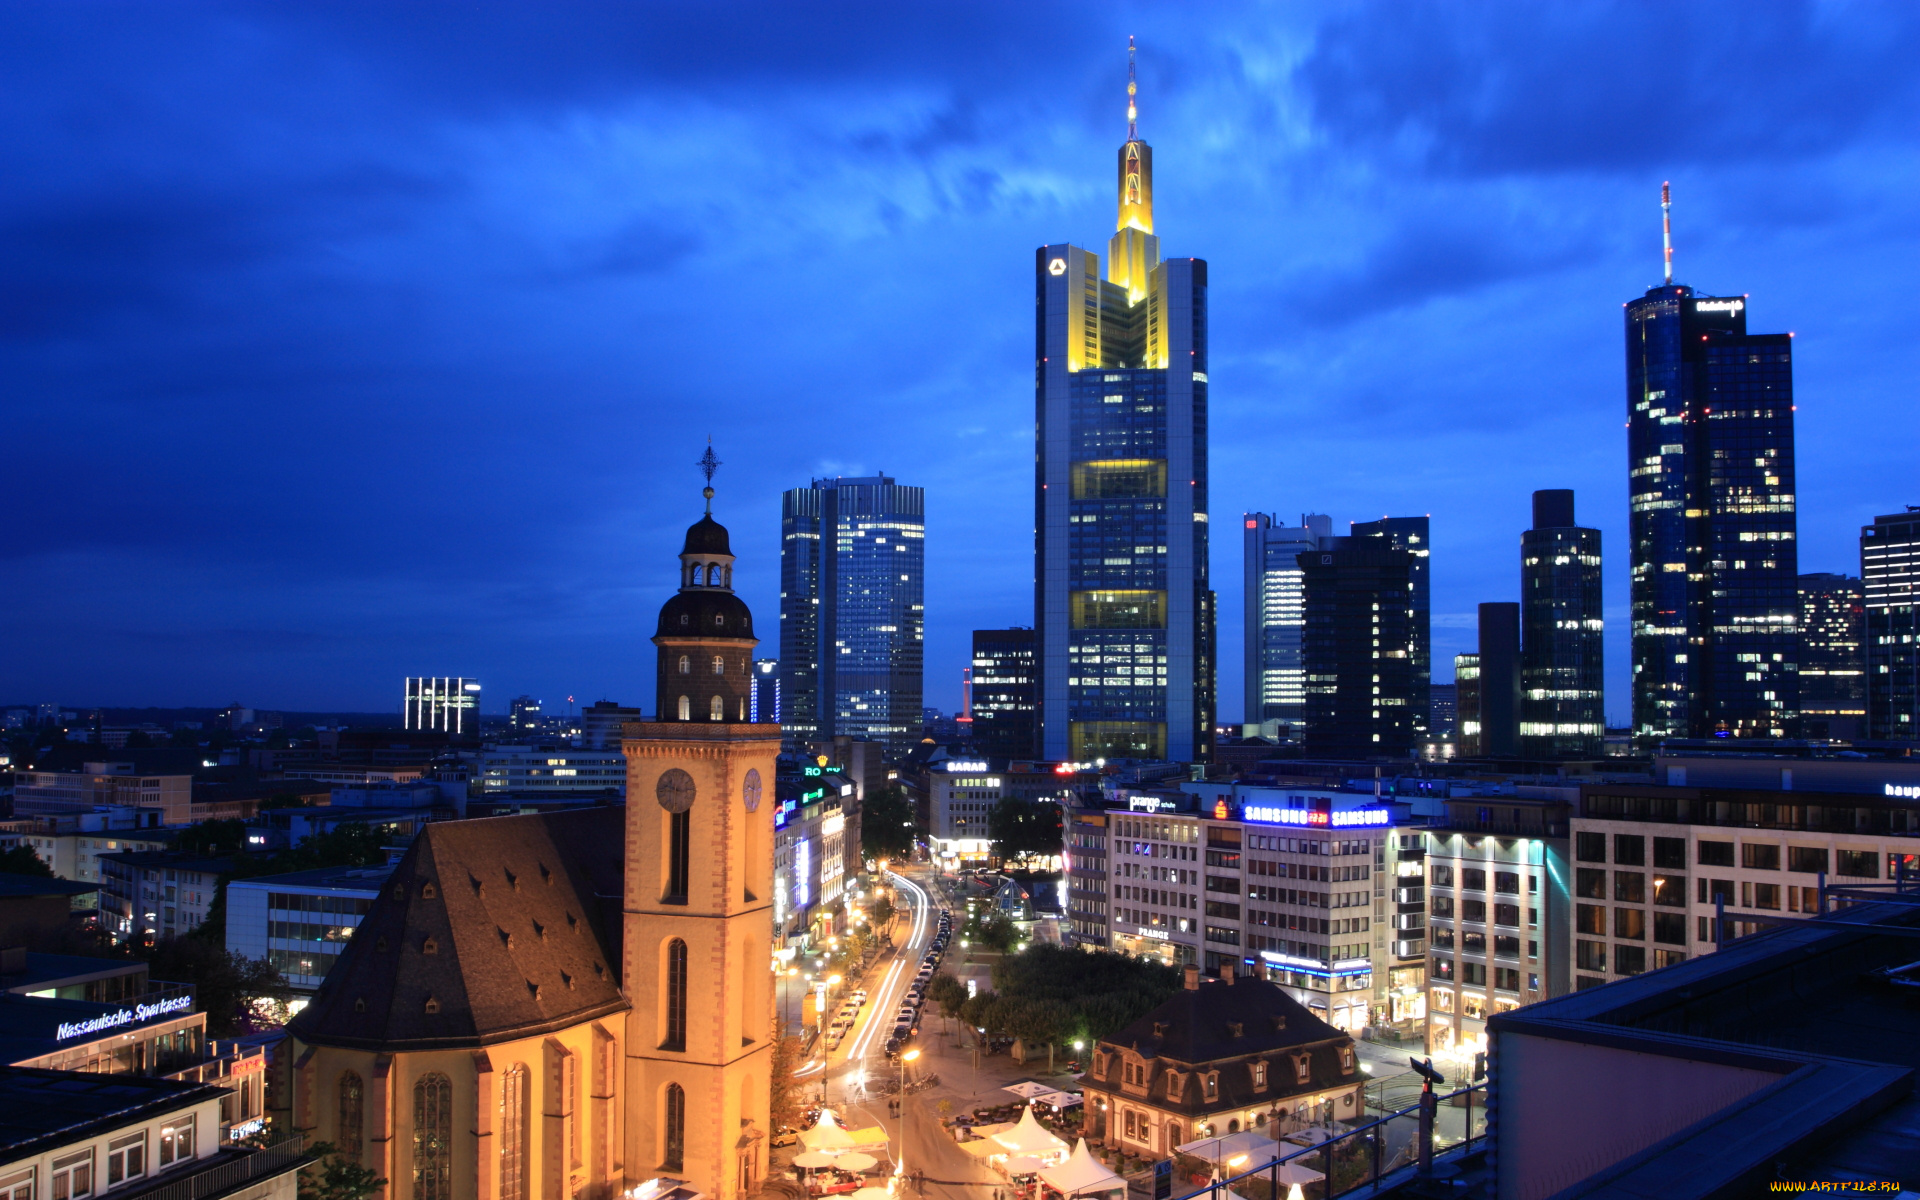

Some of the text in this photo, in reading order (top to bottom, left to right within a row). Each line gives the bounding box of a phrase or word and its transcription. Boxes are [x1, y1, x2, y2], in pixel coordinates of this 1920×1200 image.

[1130, 796, 1160, 813] prange
[1245, 806, 1307, 824] SAMSUNG
[1332, 809, 1389, 827] SAMSUNG
[1138, 927, 1170, 940] PRANGE
[56, 995, 191, 1040] Nassauische Sparkasse
